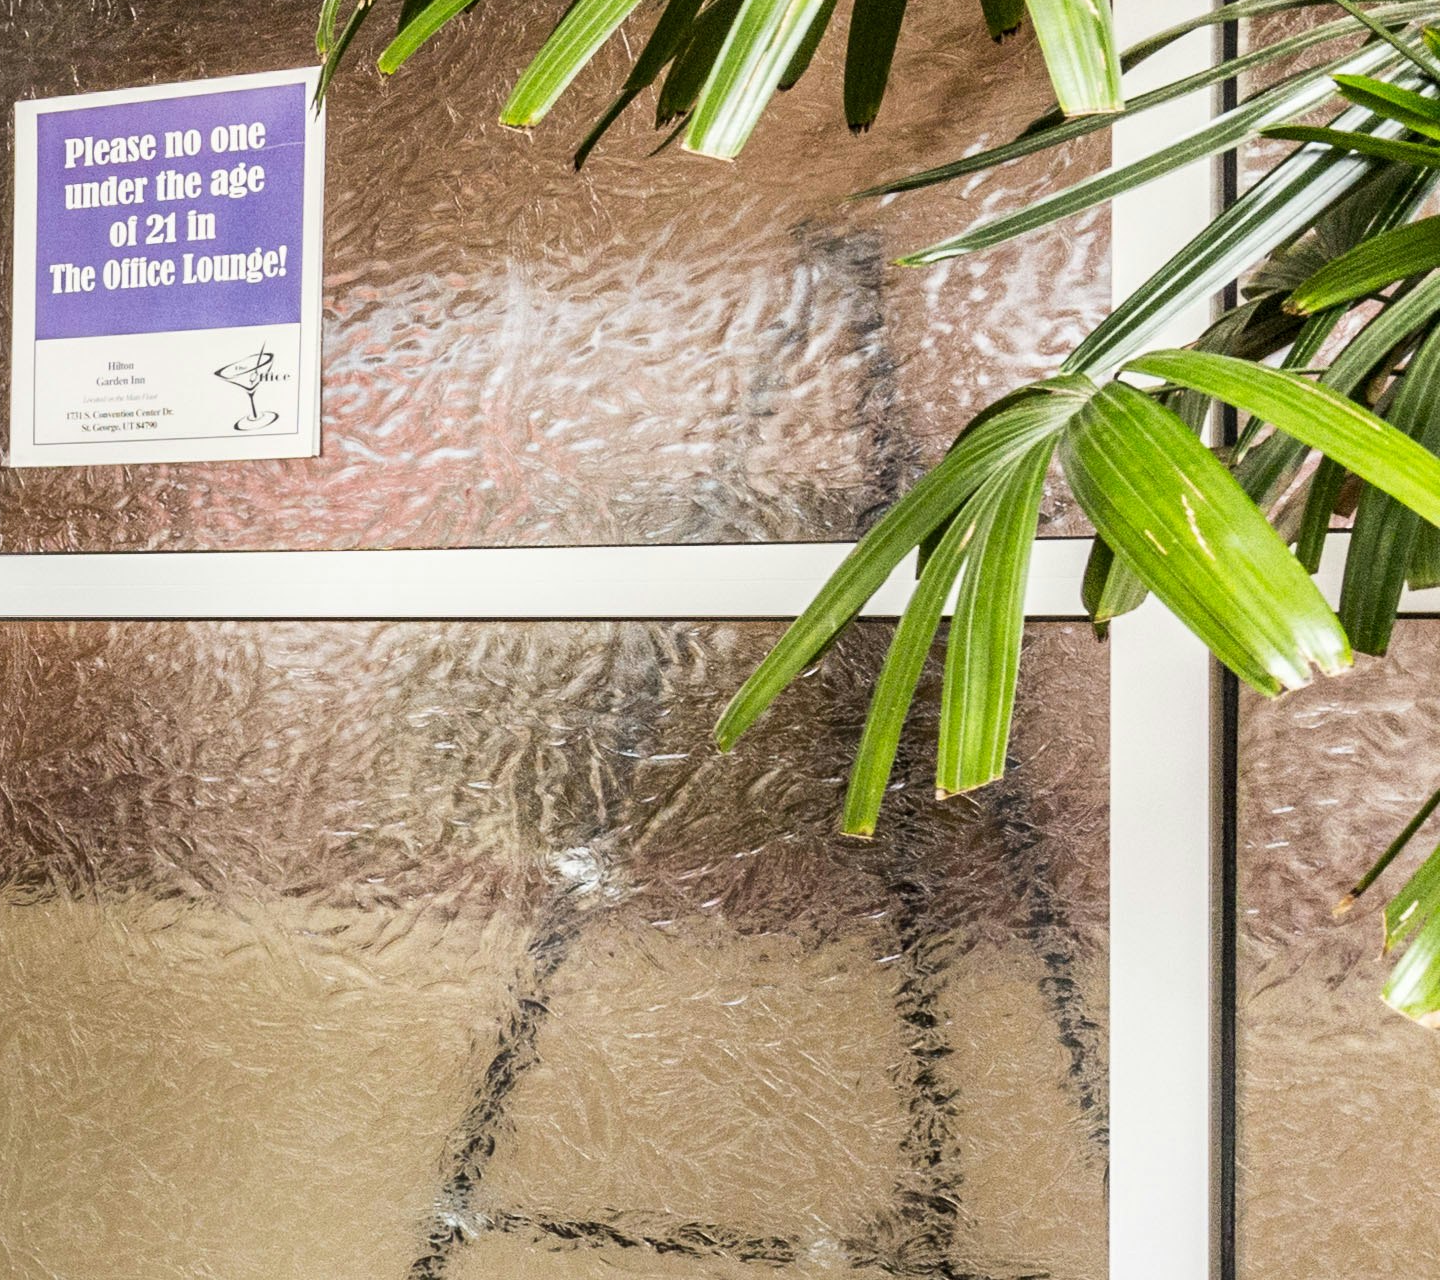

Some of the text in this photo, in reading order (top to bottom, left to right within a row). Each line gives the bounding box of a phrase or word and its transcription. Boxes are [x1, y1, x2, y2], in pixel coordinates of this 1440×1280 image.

[64, 121, 266, 169] Please no one
[64, 162, 265, 210] under the age
[109, 210, 216, 247] of 21 in
[49, 245, 288, 294] The Office Lounge!
[108, 361, 134, 371] Hilton
[96, 375, 146, 386] Garden Inn
[66, 411, 82, 420] 1731
[93, 409, 134, 419] Convention
[136, 408, 160, 418] Center
[123, 422, 134, 430] UT
[136, 420, 158, 430] 84790
